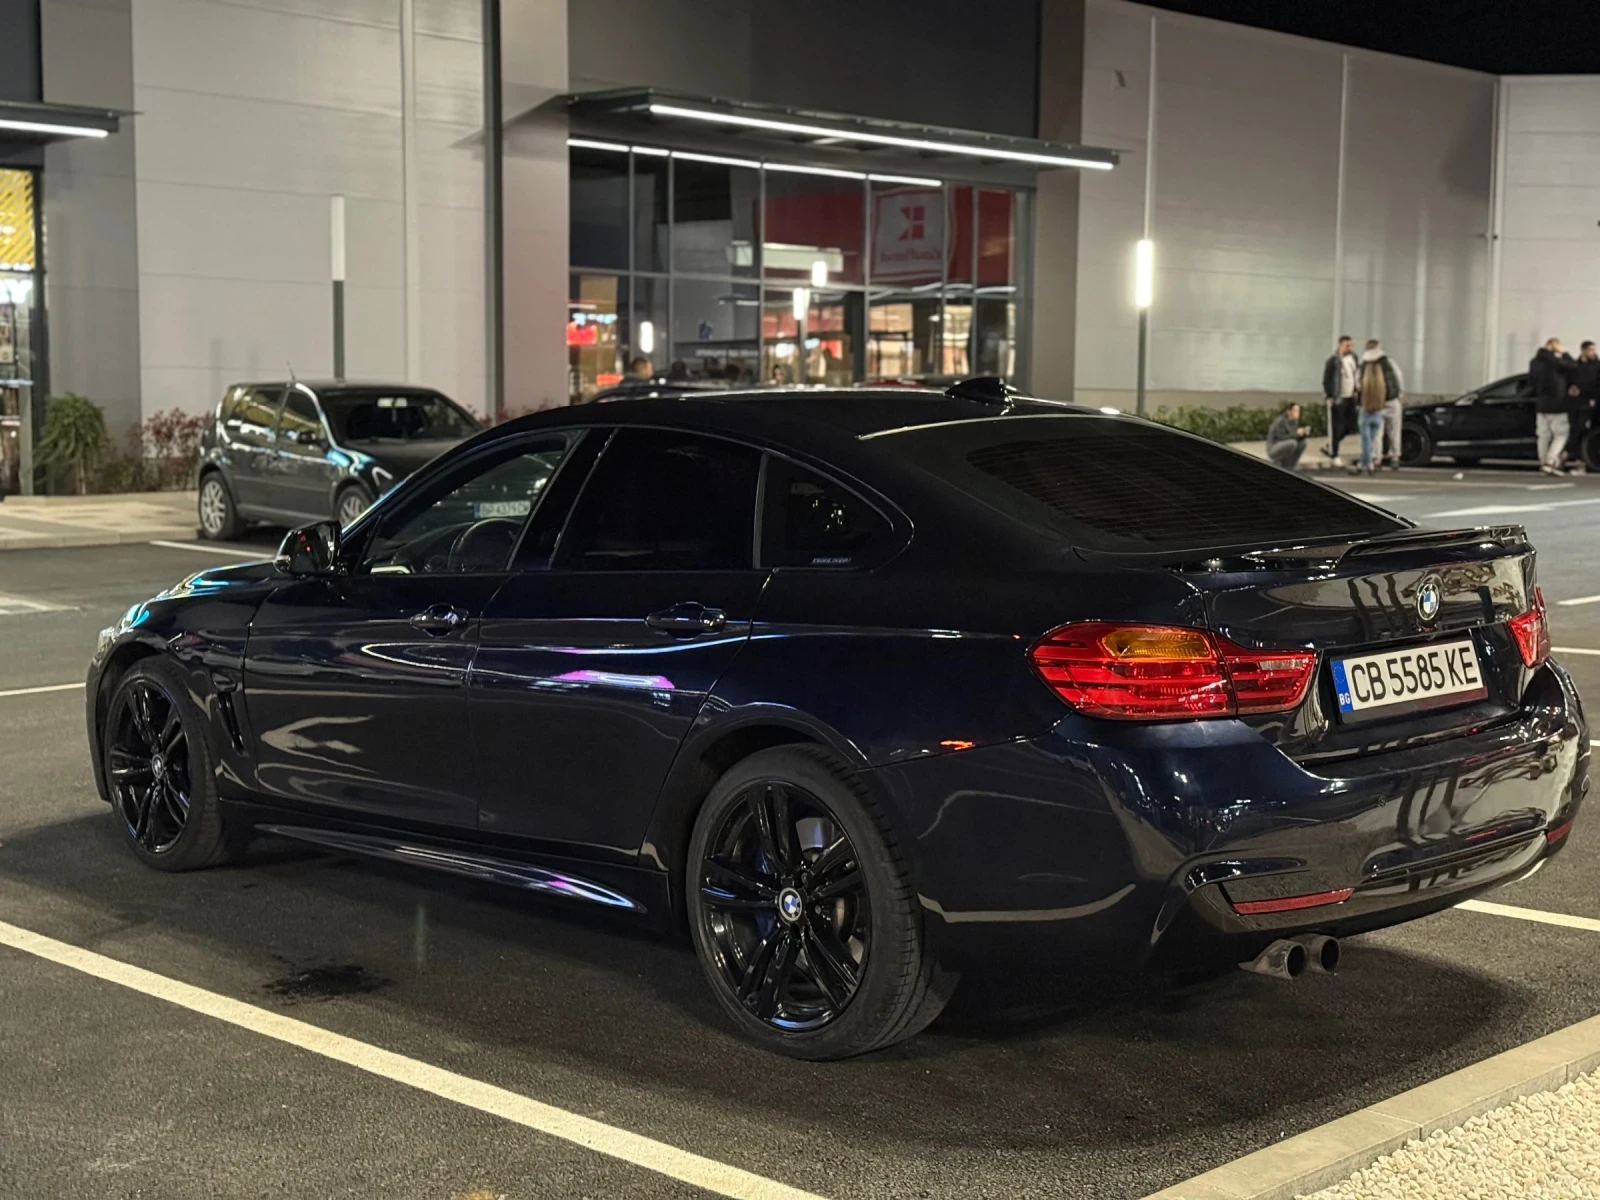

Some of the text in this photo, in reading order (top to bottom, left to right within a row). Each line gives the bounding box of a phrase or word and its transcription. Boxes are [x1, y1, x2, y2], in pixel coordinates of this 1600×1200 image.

[1351, 646, 1478, 703] CB 5585 KE
[1338, 692, 1351, 706] BG
